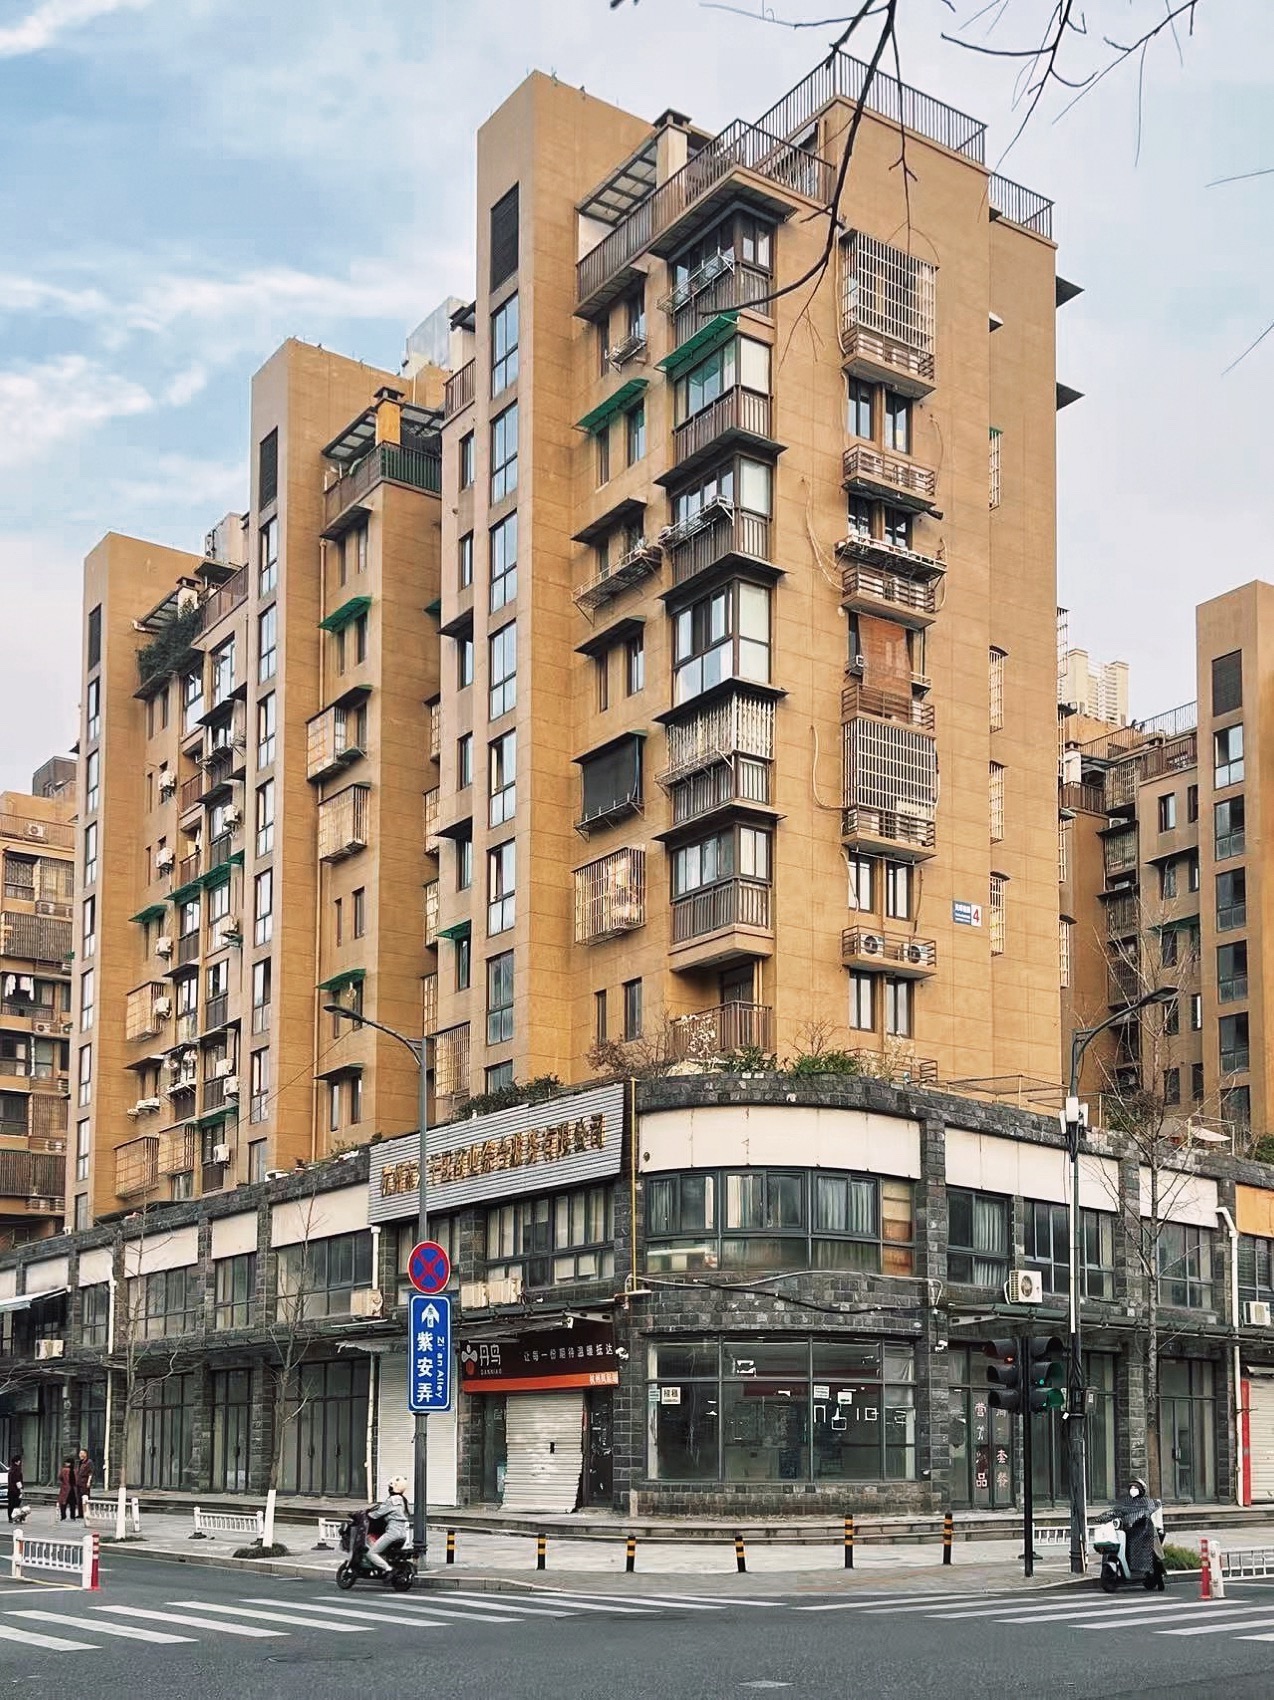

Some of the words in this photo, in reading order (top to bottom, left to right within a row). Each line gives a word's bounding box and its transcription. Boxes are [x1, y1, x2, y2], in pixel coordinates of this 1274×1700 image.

[972, 908, 980, 923] 4
[416, 1331, 434, 1403] 紫安弄
[479, 1344, 501, 1367] 丹鸟
[435, 1369, 445, 1399] Alley
